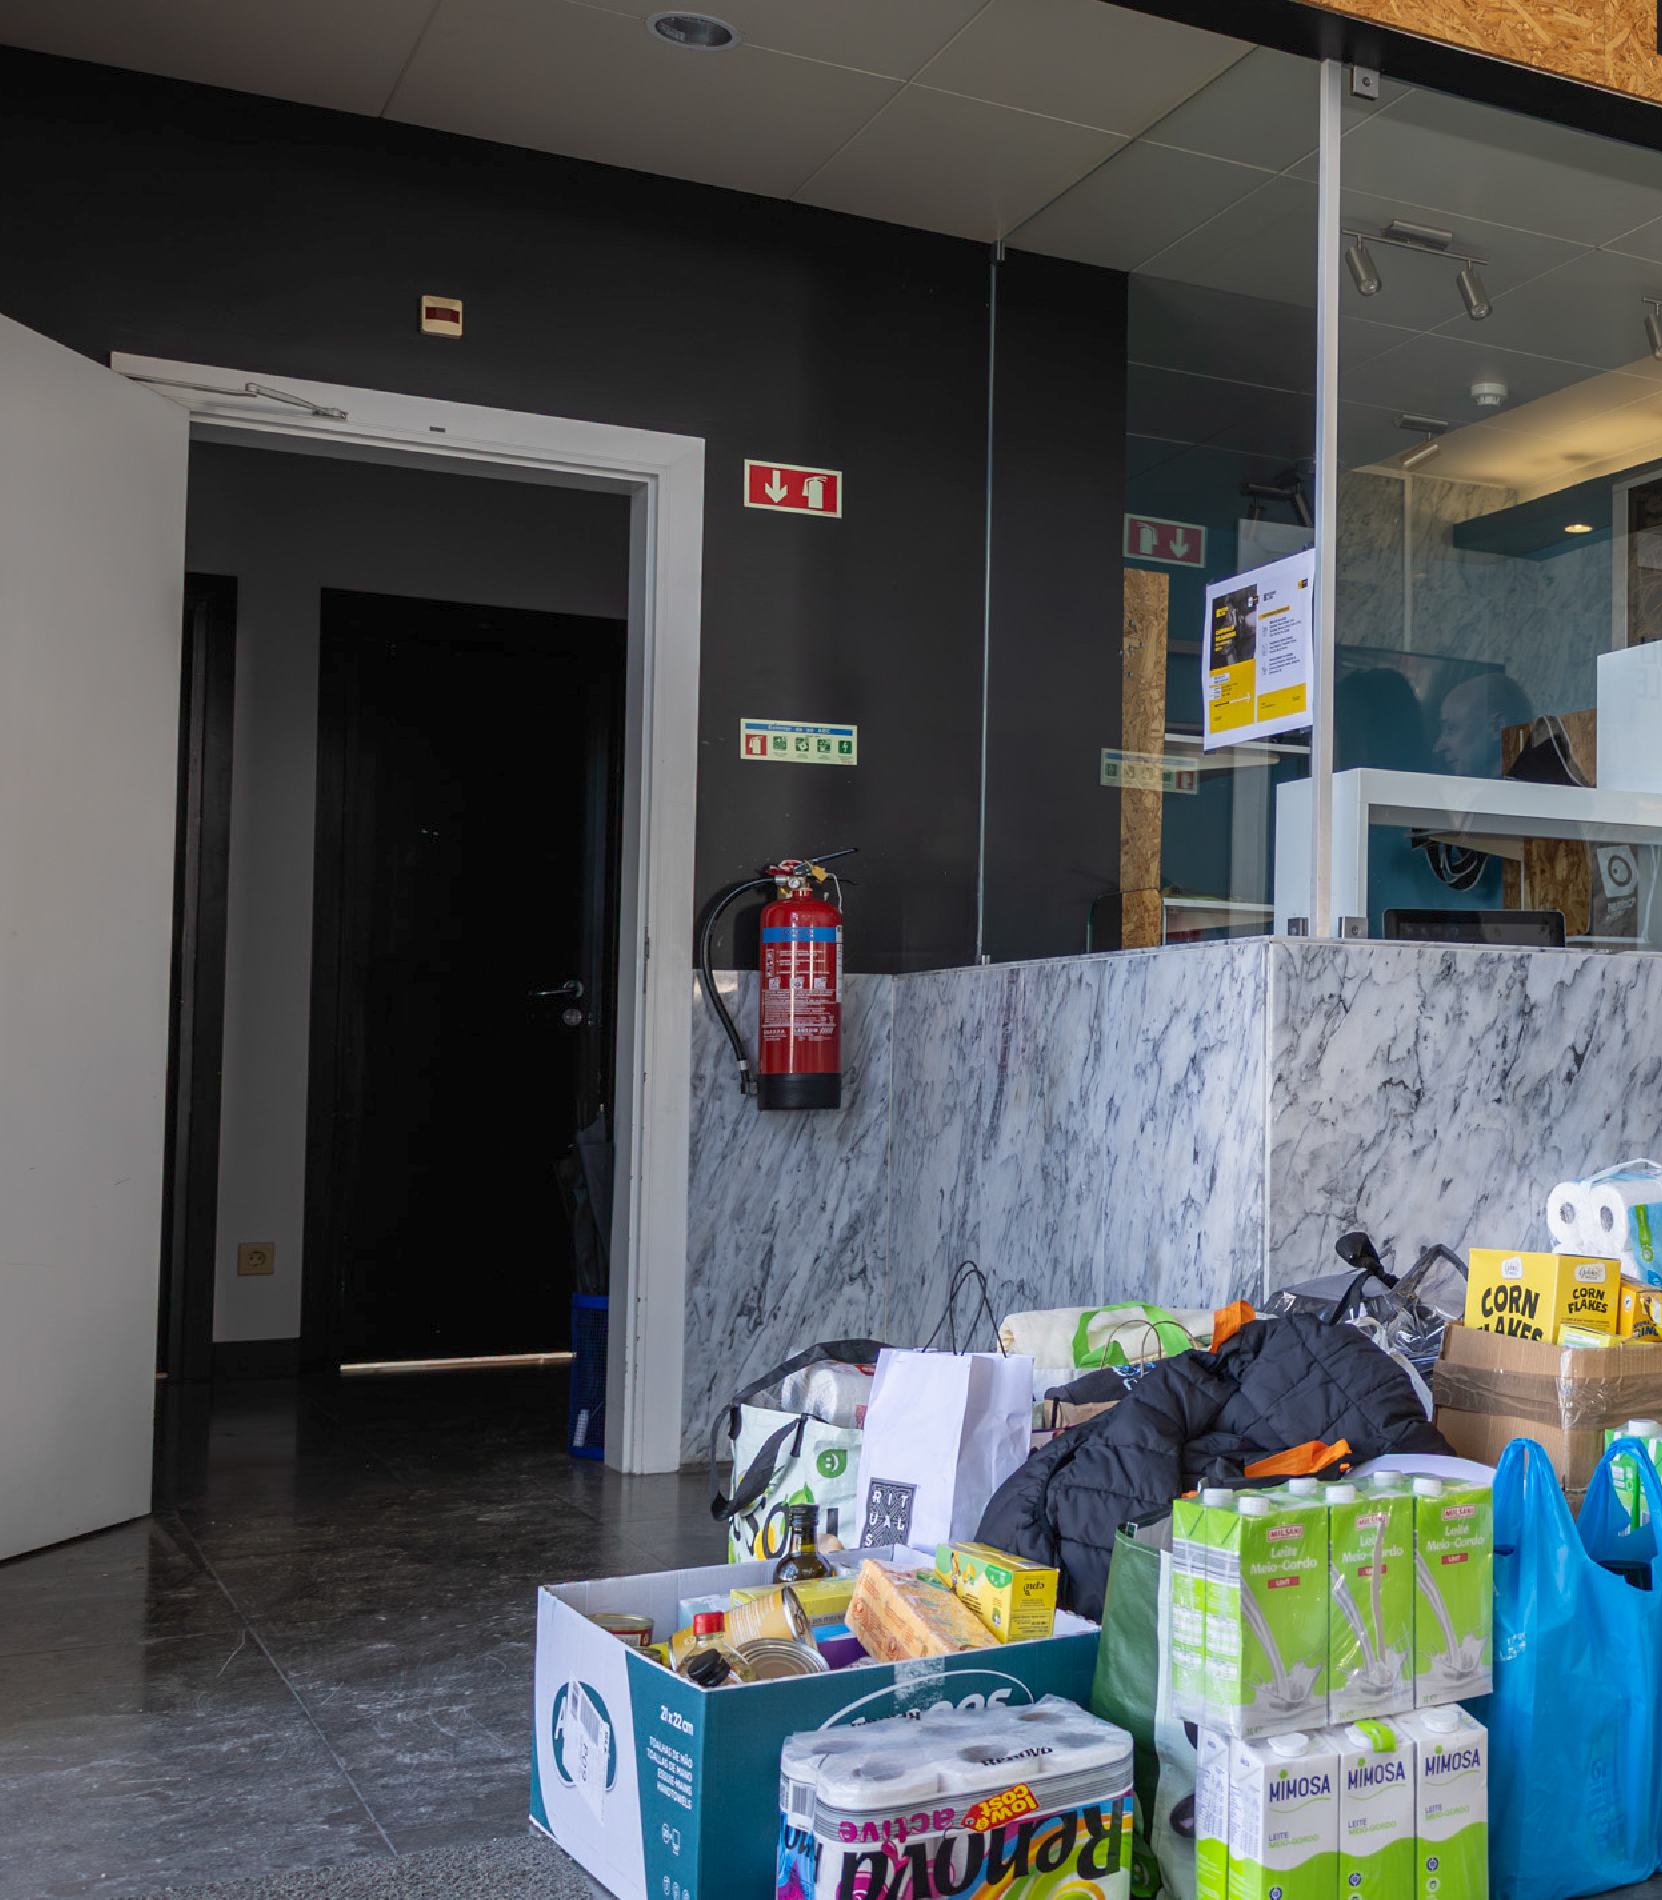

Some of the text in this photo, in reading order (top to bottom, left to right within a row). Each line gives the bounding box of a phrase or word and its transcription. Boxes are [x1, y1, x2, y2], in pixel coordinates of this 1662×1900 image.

[1481, 1284, 1541, 1320] CORN
[1572, 1287, 1606, 1302] CORN
[1568, 1300, 1609, 1315] FLAKES
[1445, 1525, 1470, 1537] Leite
[1269, 1546, 1298, 1559] Leite
[1426, 1536, 1486, 1552] Meio-Gordo
[1251, 1558, 1318, 1575] Meio-Gordo
[1425, 1746, 1481, 1777] MIMOSA
[1348, 1758, 1406, 1790] MIMOSA
[1269, 1770, 1331, 1803] MIMOSA
[979, 1783, 1030, 1816] cost
[990, 1795, 1039, 1825] low
[1425, 1803, 1443, 1814] LEITE
[838, 1807, 955, 1844] active
[1348, 1818, 1367, 1829] LEITE
[1268, 1831, 1290, 1842] LEITE
[839, 1796, 1123, 1900] Renova
